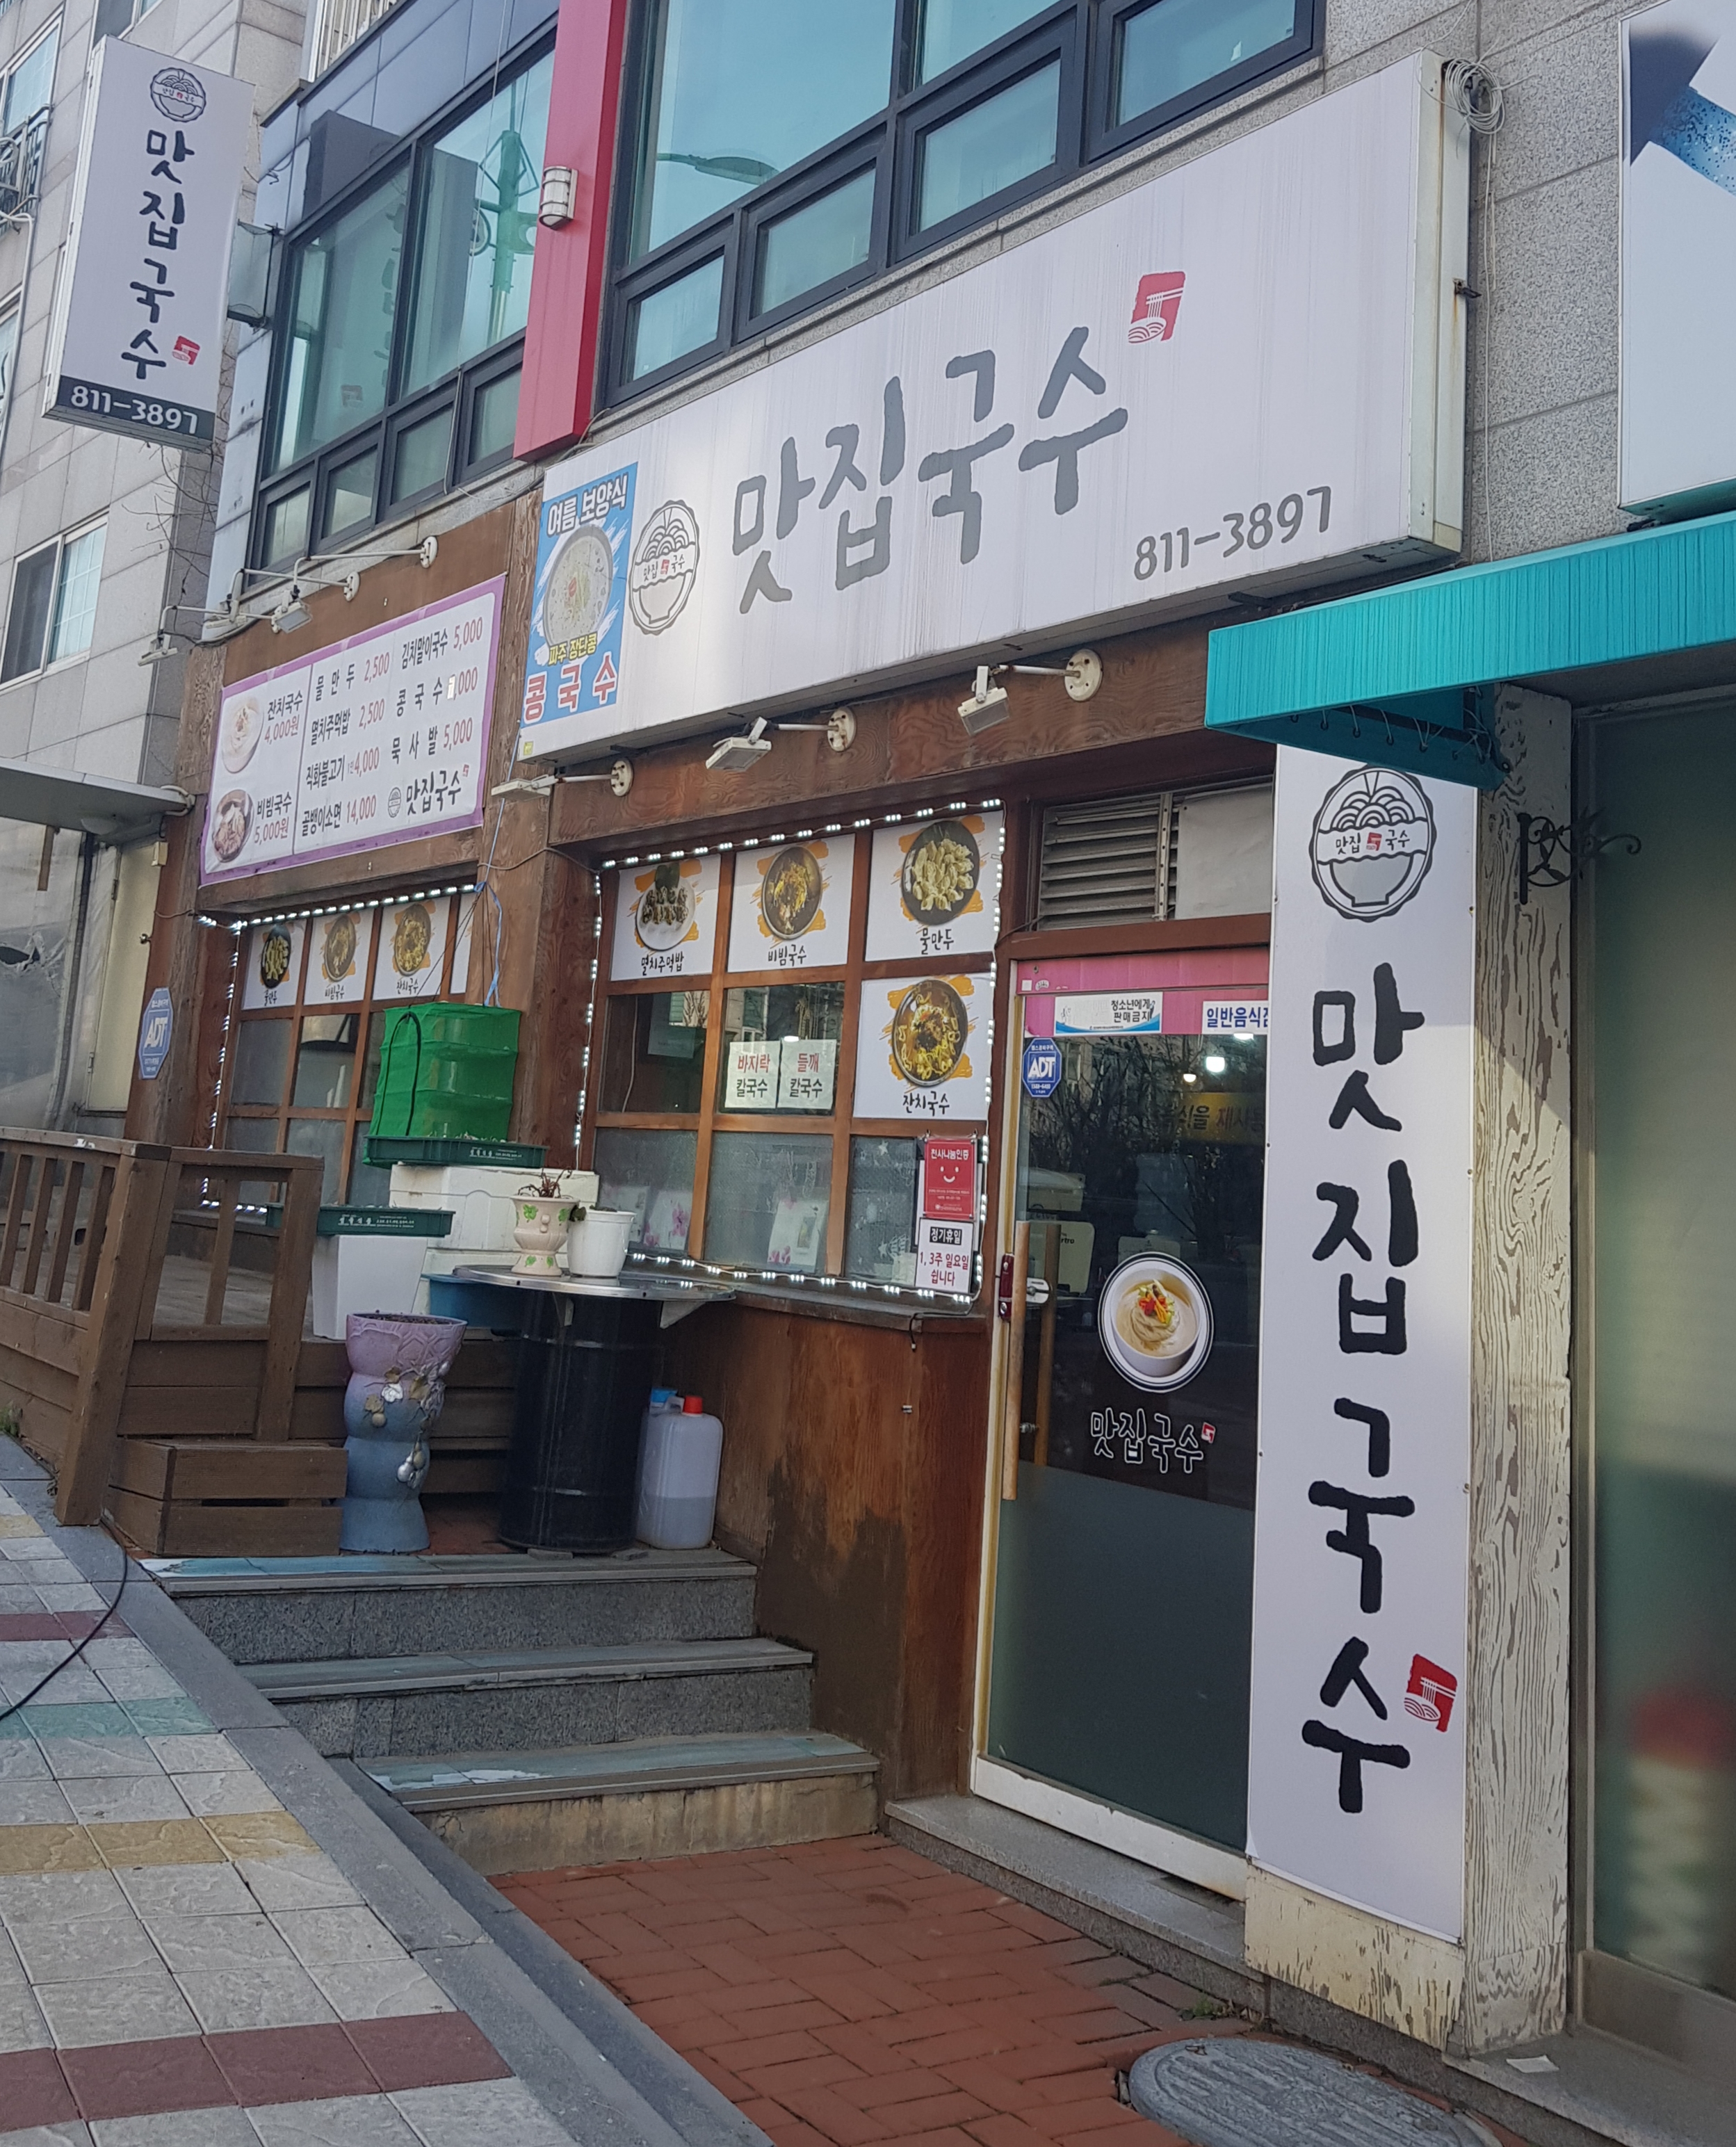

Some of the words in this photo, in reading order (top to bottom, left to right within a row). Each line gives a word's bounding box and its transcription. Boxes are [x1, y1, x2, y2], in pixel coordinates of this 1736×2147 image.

[121, 129, 195, 380] 맛집국수
[71, 386, 198, 435] 811-3897
[731, 326, 1129, 615] 맛집국수
[547, 495, 578, 537] 여름
[580, 473, 628, 525] 보양식
[1133, 485, 1333, 581] 811-3897
[401, 627, 448, 670] 김치말이국수
[453, 616, 483, 651] 5,000
[364, 651, 390, 683] 2,500
[446, 666, 478, 701] ,000
[267, 689, 304, 722] 잔치국수
[264, 714, 300, 744] 4,000원
[311, 708, 351, 746] 멸치주먹밥
[358, 697, 385, 730] 2,500
[444, 717, 473, 750] 5,000
[306, 754, 346, 791] 직화불고기
[256, 791, 292, 819] 비빔국수
[407, 770, 461, 816] 맛집국수
[346, 794, 377, 825] 14,000
[254, 818, 289, 844] 5,000원
[1335, 833, 1361, 855] 맛집
[1384, 828, 1411, 850] 국수
[768, 944, 807, 969] 비빔국수
[920, 928, 955, 955] 물만두
[640, 951, 685, 976] 멸치주먹밥
[1111, 998, 1151, 1011] 청소년에게
[1114, 1011, 1151, 1023] 판매금지
[143, 1017, 168, 1048] ADT
[738, 1054, 770, 1073] 바지락
[797, 1053, 819, 1072] 들깨
[1028, 1056, 1056, 1078] ADT
[736, 1079, 768, 1099] 칼국수
[790, 1078, 823, 1099] 칼국수
[903, 1092, 950, 1116] 잔치국수
[932, 1227, 962, 1245] 정기휴일
[946, 1254, 968, 1270] 일요일
[931, 1269, 955, 1286] 쉽니다
[1302, 963, 1425, 1814] 맛집국수
[1091, 1407, 1203, 1474] 맛집국수
